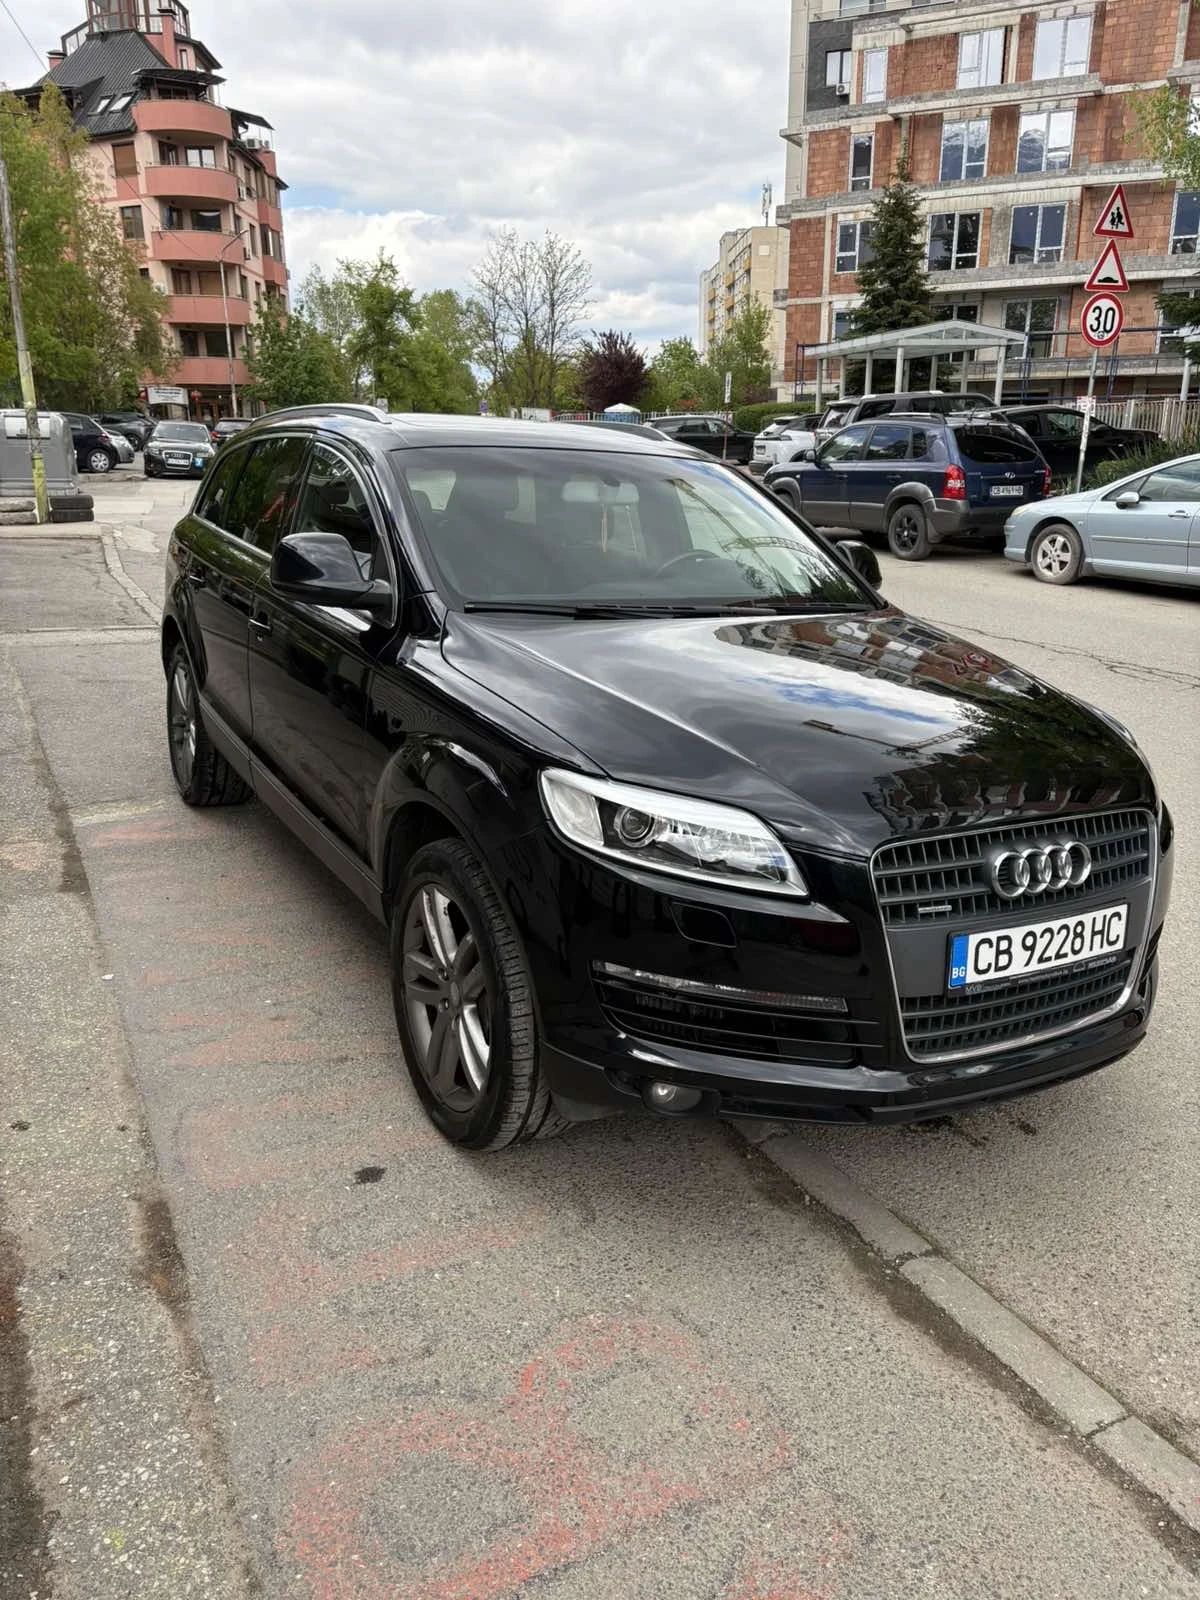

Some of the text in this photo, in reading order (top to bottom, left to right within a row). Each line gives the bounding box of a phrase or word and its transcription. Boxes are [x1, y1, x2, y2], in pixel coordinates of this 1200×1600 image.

[1090, 306, 1115, 333] 30
[974, 912, 1122, 975] CB 9228 HC
[951, 966, 966, 979] BG
